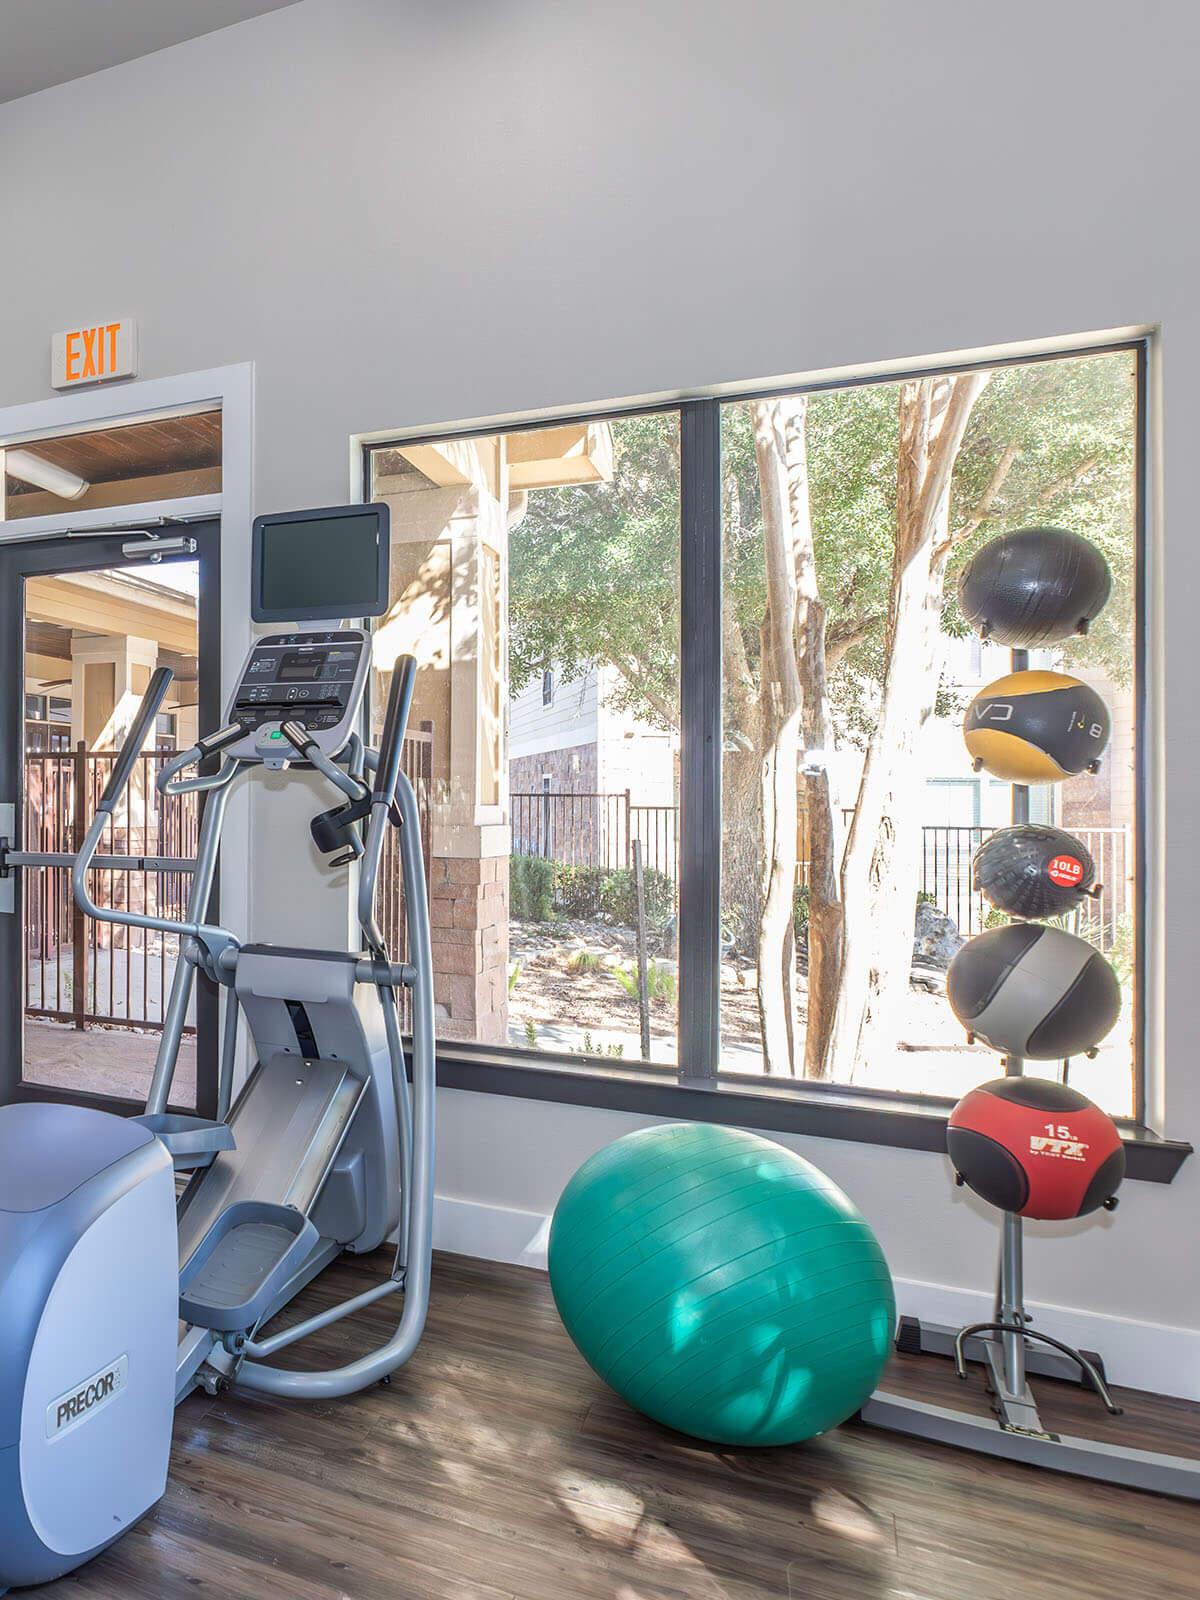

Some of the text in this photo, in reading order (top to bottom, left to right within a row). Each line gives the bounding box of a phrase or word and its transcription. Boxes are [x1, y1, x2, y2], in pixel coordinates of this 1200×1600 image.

[66, 323, 121, 381] EXIT
[1052, 859, 1081, 874] 10LB
[57, 1371, 114, 1428] PRECOR
